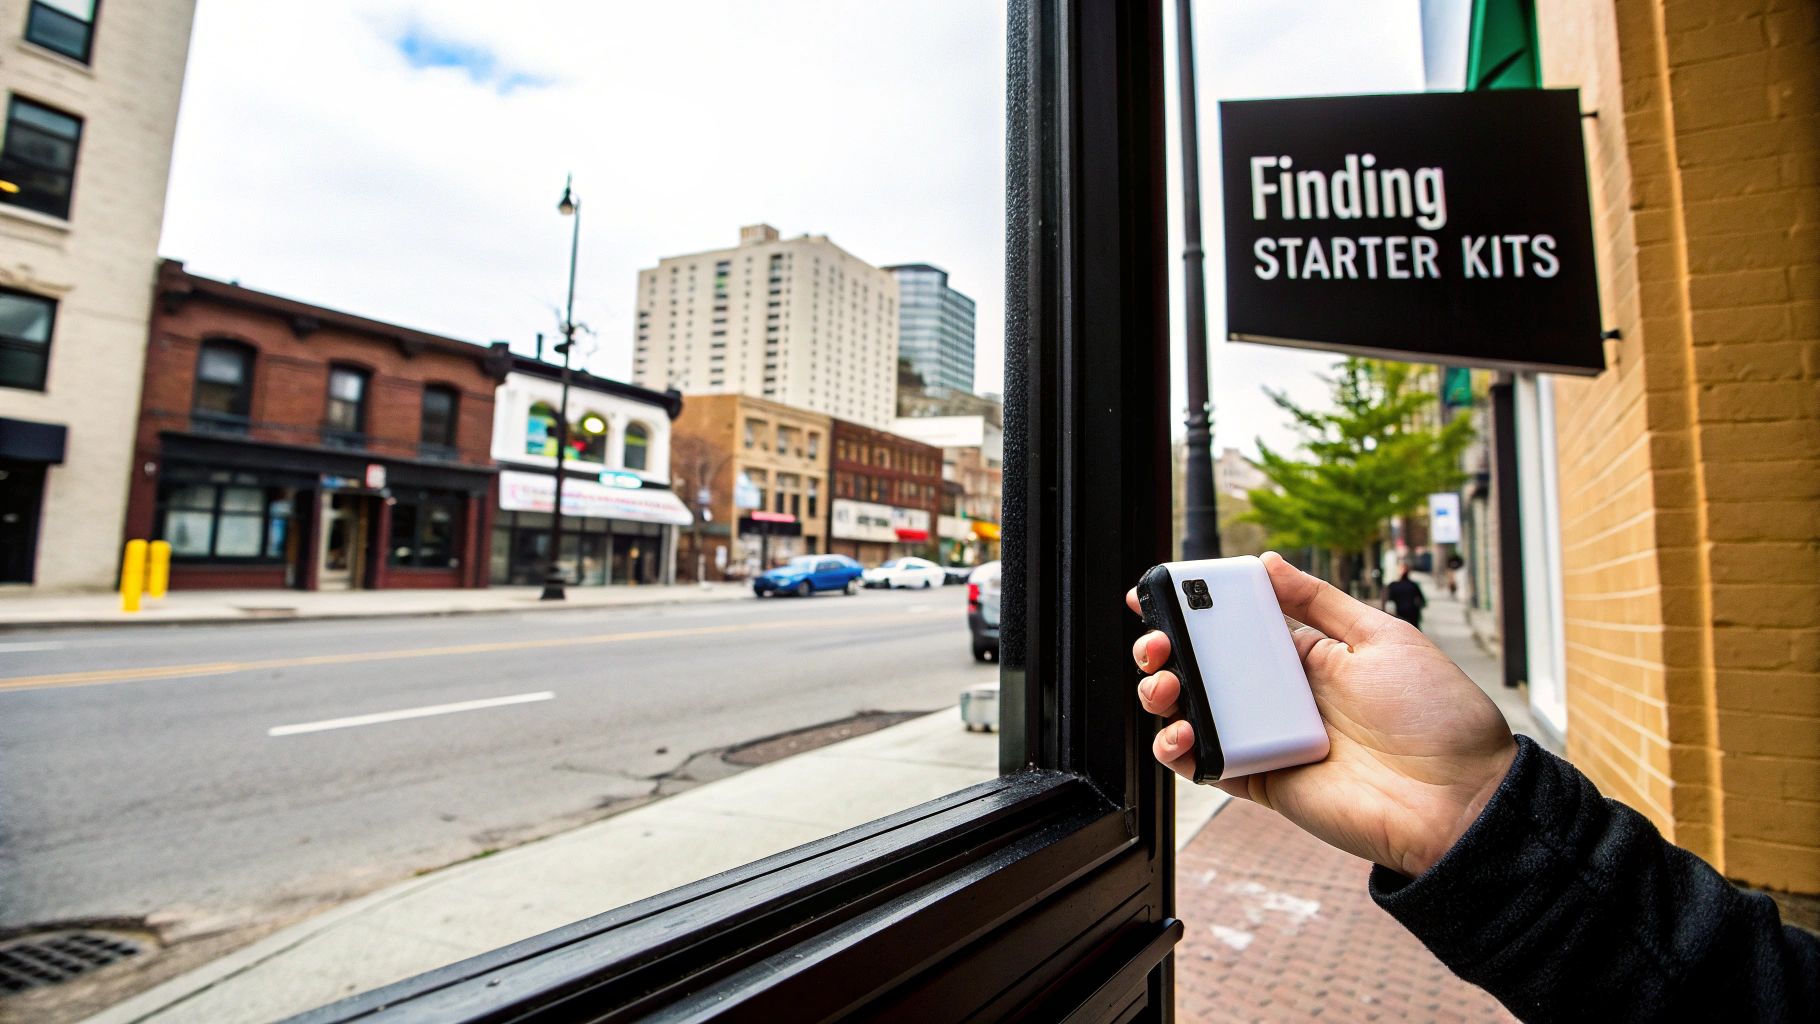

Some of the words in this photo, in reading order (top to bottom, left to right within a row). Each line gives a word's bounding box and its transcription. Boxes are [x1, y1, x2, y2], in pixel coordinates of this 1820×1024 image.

[1251, 154, 1447, 230] Finding
[1254, 236, 1440, 279] STARTER
[1462, 234, 1560, 278] KITS
